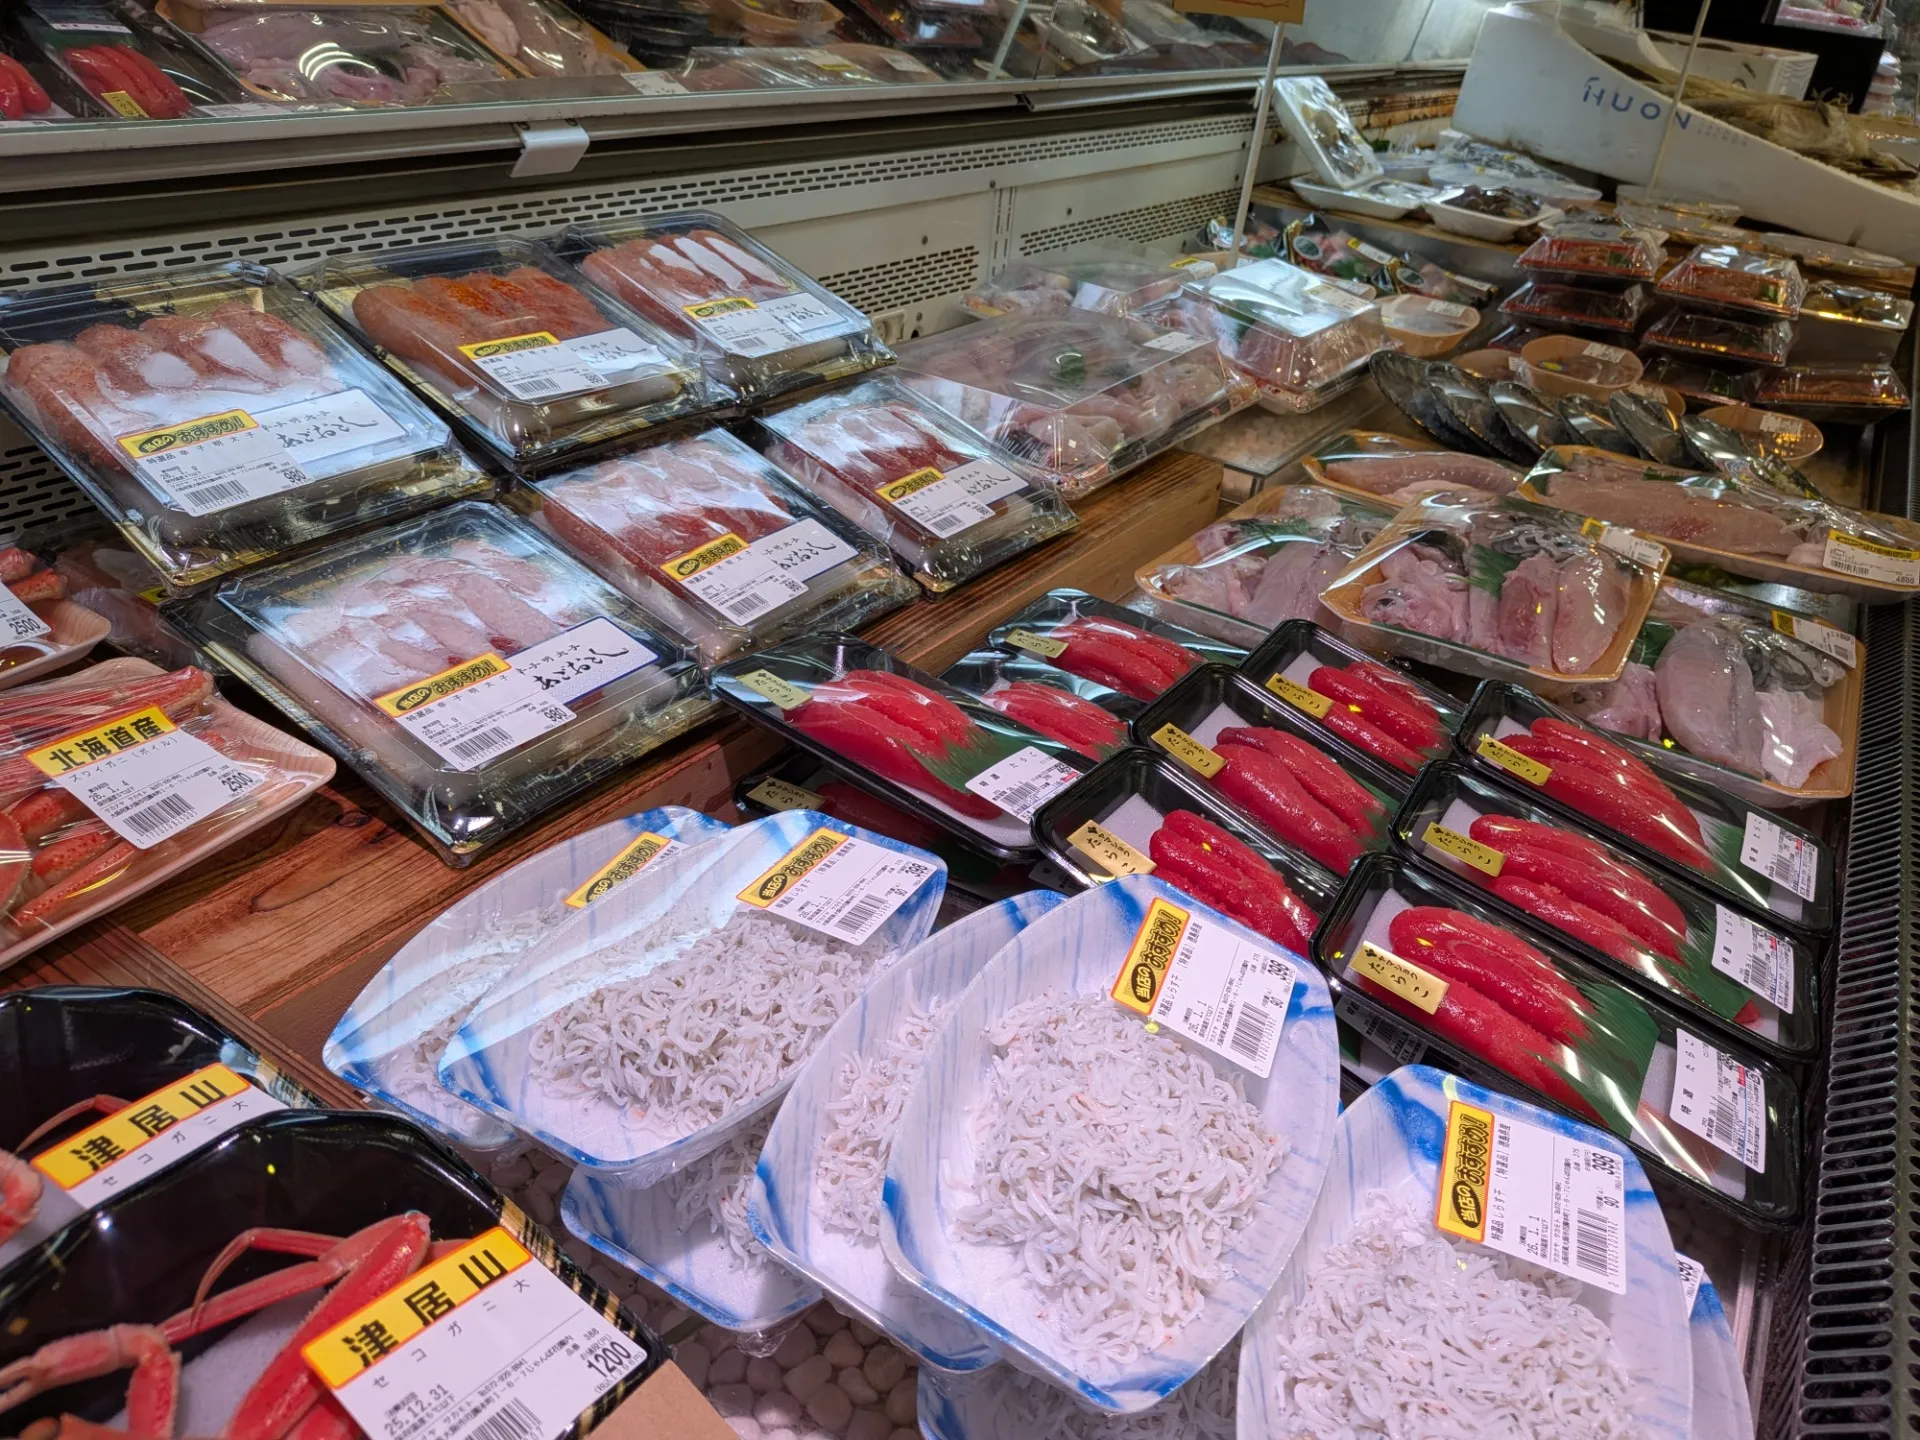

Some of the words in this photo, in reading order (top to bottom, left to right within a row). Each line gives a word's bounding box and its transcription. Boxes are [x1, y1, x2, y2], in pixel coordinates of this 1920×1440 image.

[1583, 77, 1692, 130] HUON
[143, 434, 173, 452] 当店の
[282, 469, 307, 483] 980
[9, 618, 40, 635] 2500
[532, 647, 629, 690] あごおとし
[399, 688, 431, 711] 当店の
[405, 706, 438, 722] 特選品
[438, 674, 508, 710] 辛子明太子
[542, 706, 568, 722] 980
[49, 716, 165, 772] 北海道産
[1166, 737, 1210, 767] たらこ
[1491, 751, 1537, 777] たらこ
[219, 771, 254, 792] 2500
[610, 839, 661, 881] おすすめ!
[761, 873, 786, 898] 当店の
[785, 835, 838, 877] おすすめ!
[1086, 837, 1136, 874] たらこ
[1437, 837, 1491, 865] たらこ
[903, 862, 929, 877] 398
[1141, 909, 1182, 970] おすすめ!
[1136, 965, 1154, 999] 当店の
[1267, 958, 1289, 981] 398
[1368, 962, 1429, 998] たらこ
[1270, 995, 1283, 1009] 90
[70, 1080, 227, 1172] 津居山
[1455, 1114, 1489, 1186] おすすめ!
[1592, 1151, 1613, 1175] 398
[1456, 1185, 1478, 1223] 当店の
[1491, 1187, 1506, 1219] しらす干
[1604, 1195, 1618, 1209] 90
[1490, 1218, 1504, 1242] 特選品
[342, 1249, 508, 1368] 津居山
[373, 1278, 530, 1389] セコガニ大
[587, 1341, 631, 1377] 1200
[384, 1384, 450, 1436] 25.12.31
[443, 1399, 473, 1424] サカモト
